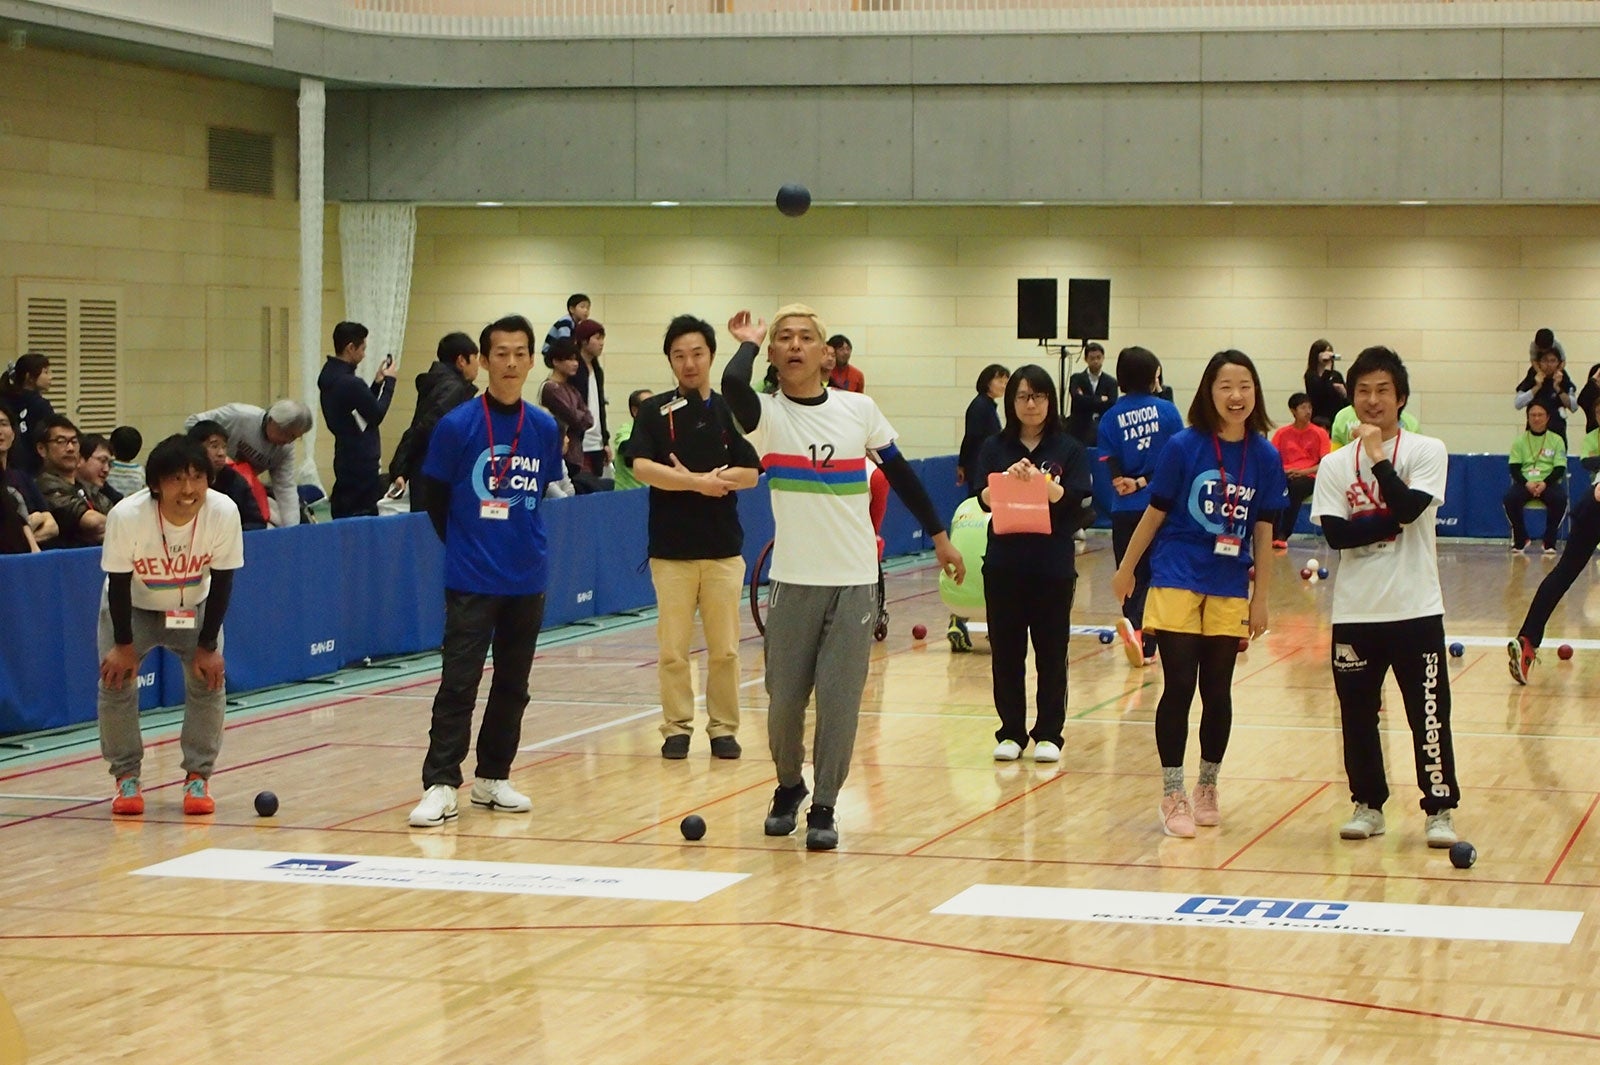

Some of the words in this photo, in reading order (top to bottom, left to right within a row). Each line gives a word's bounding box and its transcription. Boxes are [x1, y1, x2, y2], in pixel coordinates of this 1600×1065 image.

[1117, 405, 1159, 428] M.TOYODA
[1124, 421, 1159, 441] JAPAN
[809, 444, 836, 468] 12
[1422, 652, 1450, 798] gol.deportes
[1174, 897, 1349, 921] CAC
[1268, 921, 1407, 933] Holdings
